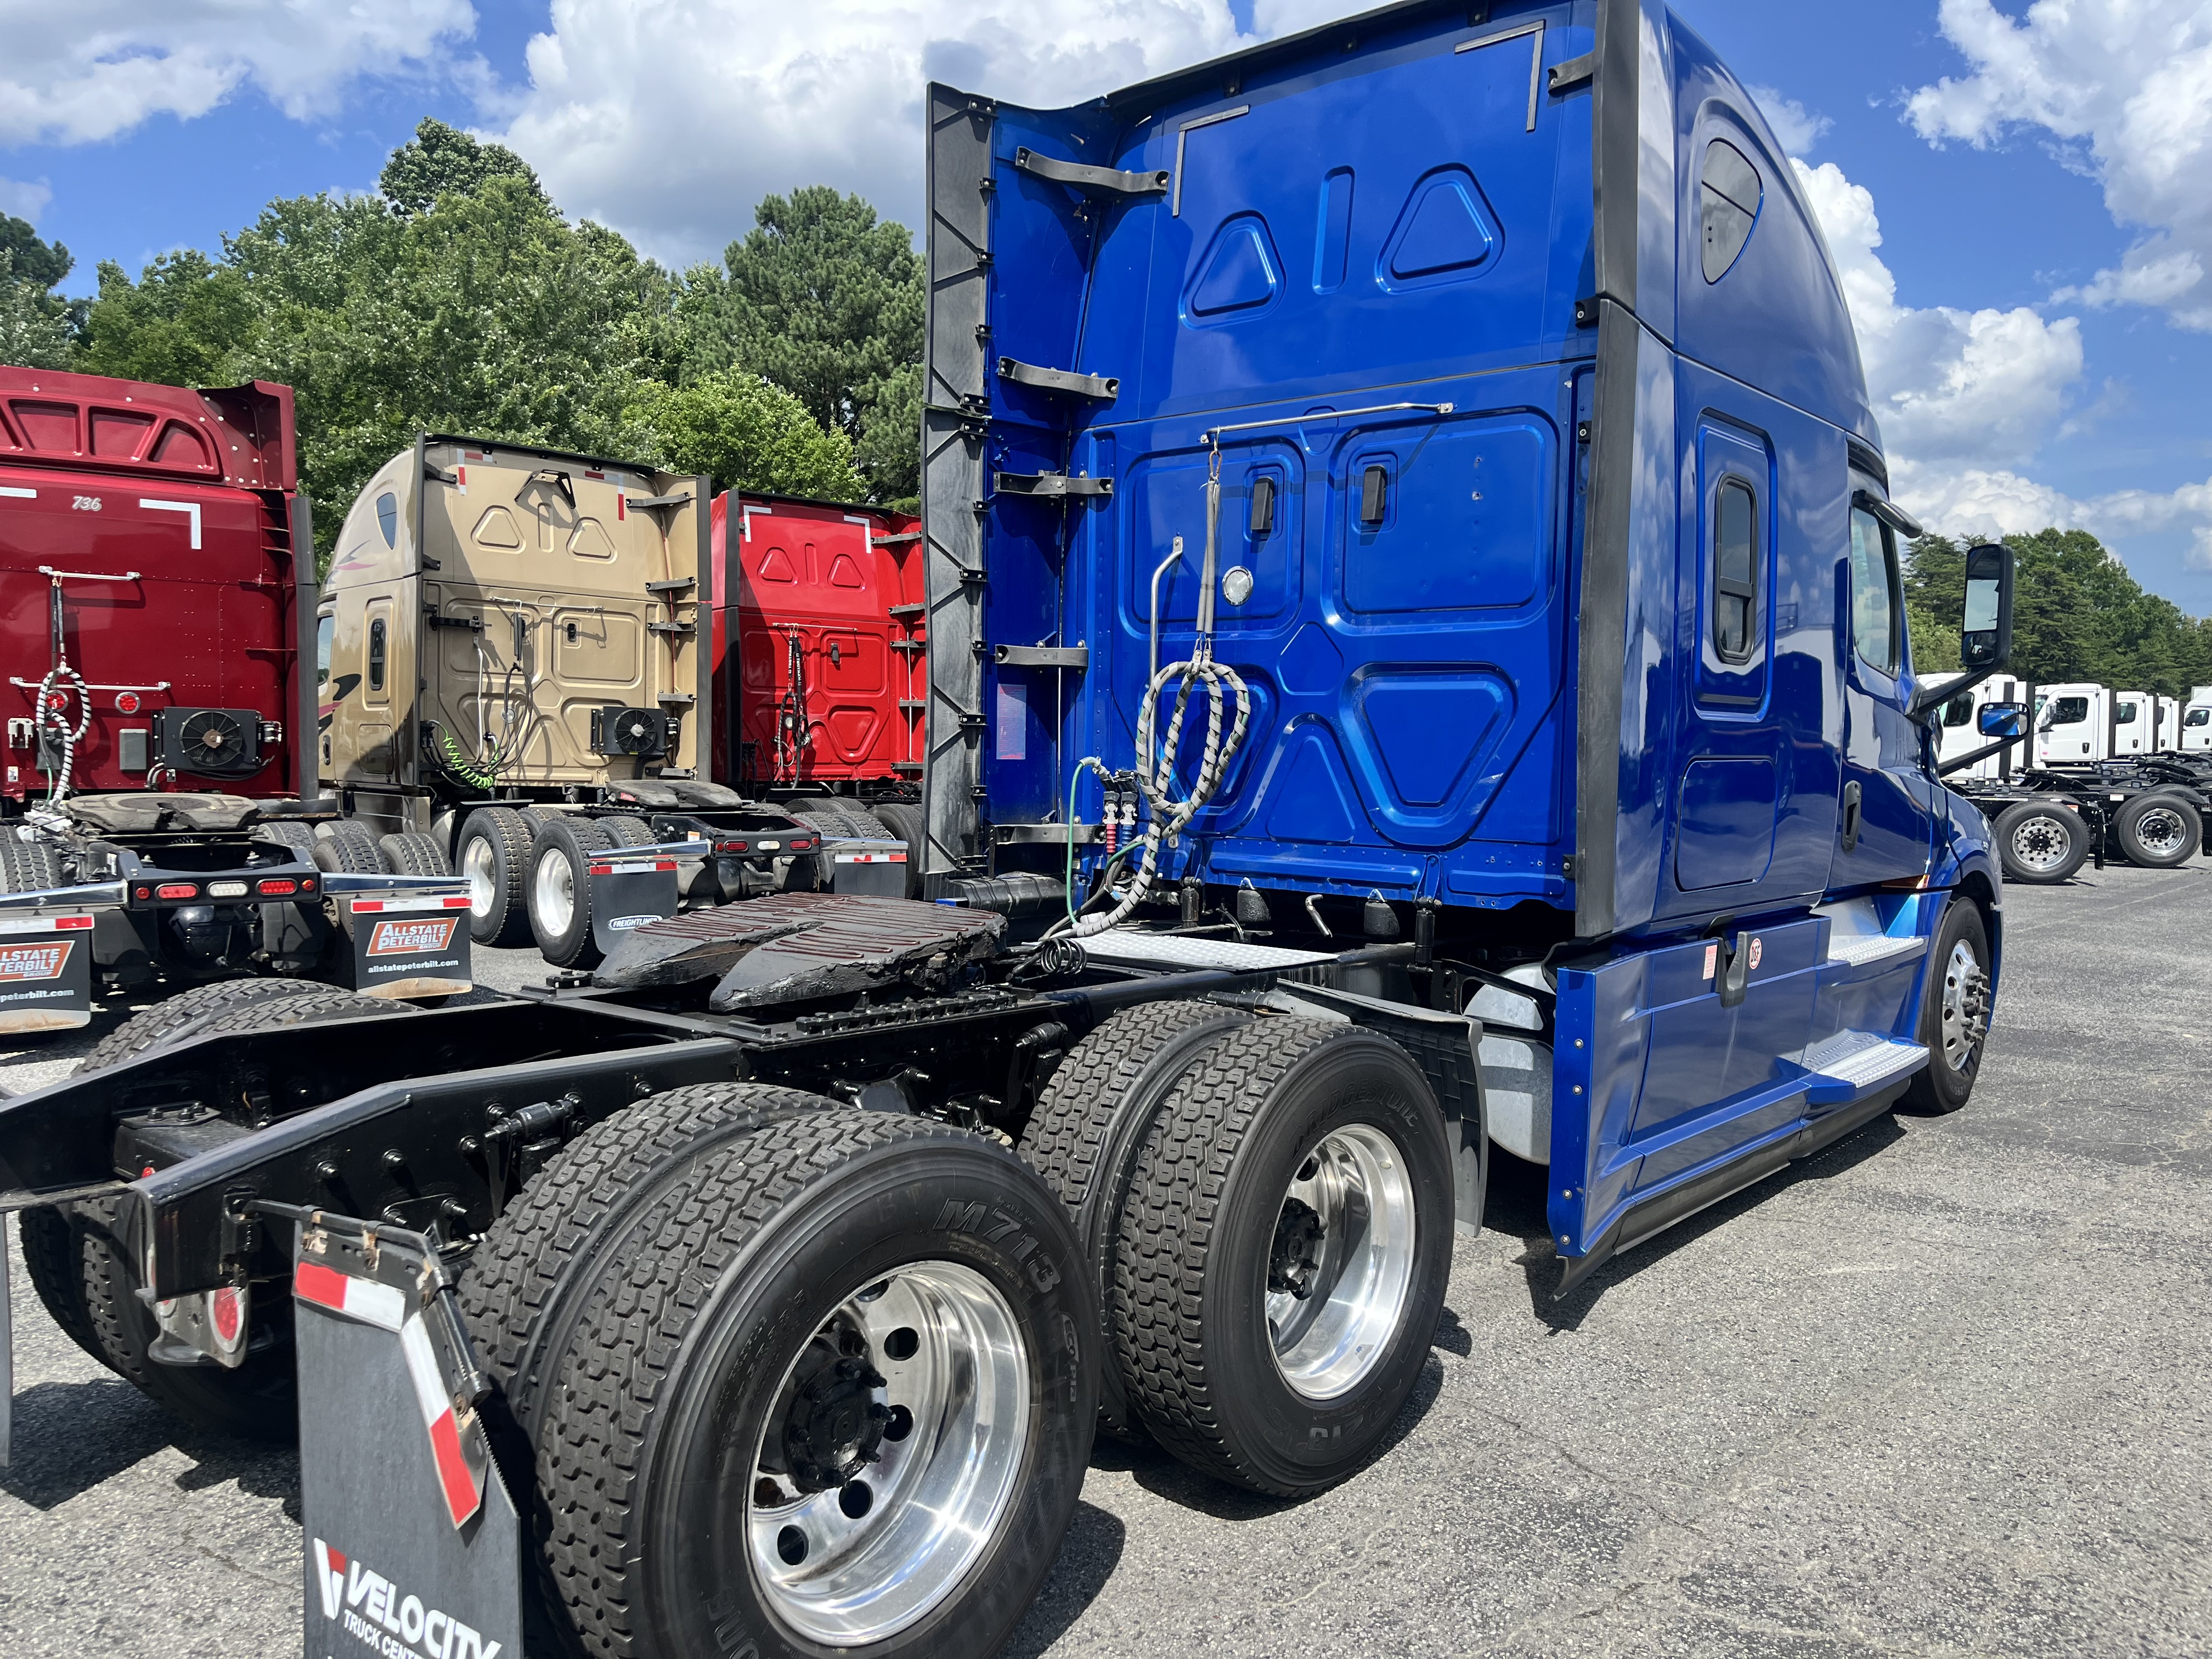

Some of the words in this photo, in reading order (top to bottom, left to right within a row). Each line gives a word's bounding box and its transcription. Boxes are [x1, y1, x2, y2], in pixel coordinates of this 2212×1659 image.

[72, 495, 102, 511] 736
[380, 923, 448, 938] ALLSTATE
[377, 933, 446, 951] PETERBILT
[0, 948, 60, 962] LSTATE
[368, 960, 459, 973] allstatepeterbilt.com
[1290, 1078, 1420, 1164] BRIDGESTONE
[933, 1198, 1061, 1294] M713
[347, 1560, 502, 1659] VELOCITY
[344, 1609, 382, 1650] TRUCK
